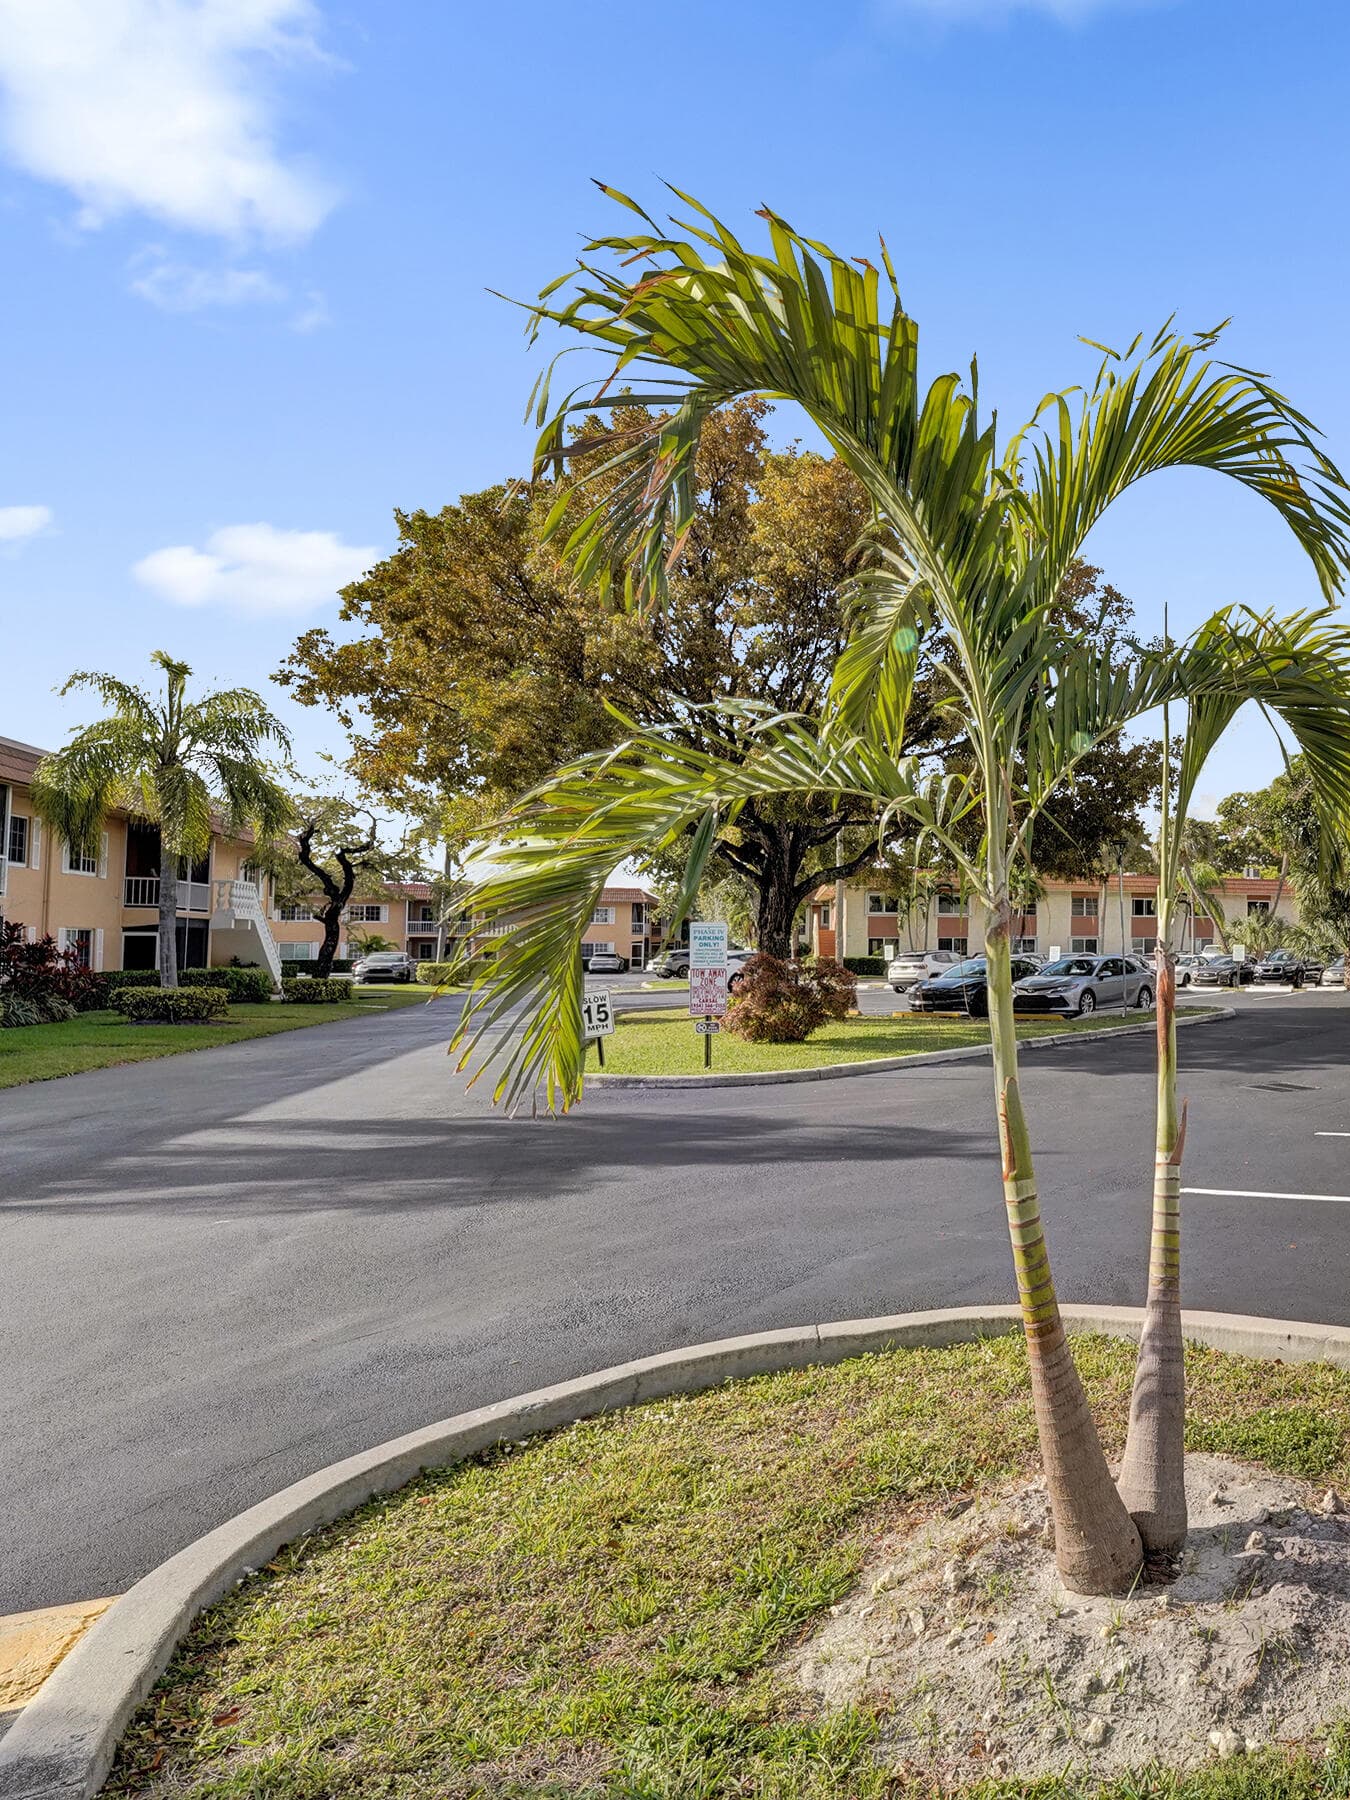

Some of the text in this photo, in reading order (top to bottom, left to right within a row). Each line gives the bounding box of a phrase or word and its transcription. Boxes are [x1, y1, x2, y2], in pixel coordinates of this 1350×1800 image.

[691, 969, 725, 978] TOW AWAY
[700, 977, 717, 987] ZONE
[583, 995, 607, 1005] SLOW
[583, 1003, 609, 1025] 15
[587, 1023, 609, 1032] MPH
